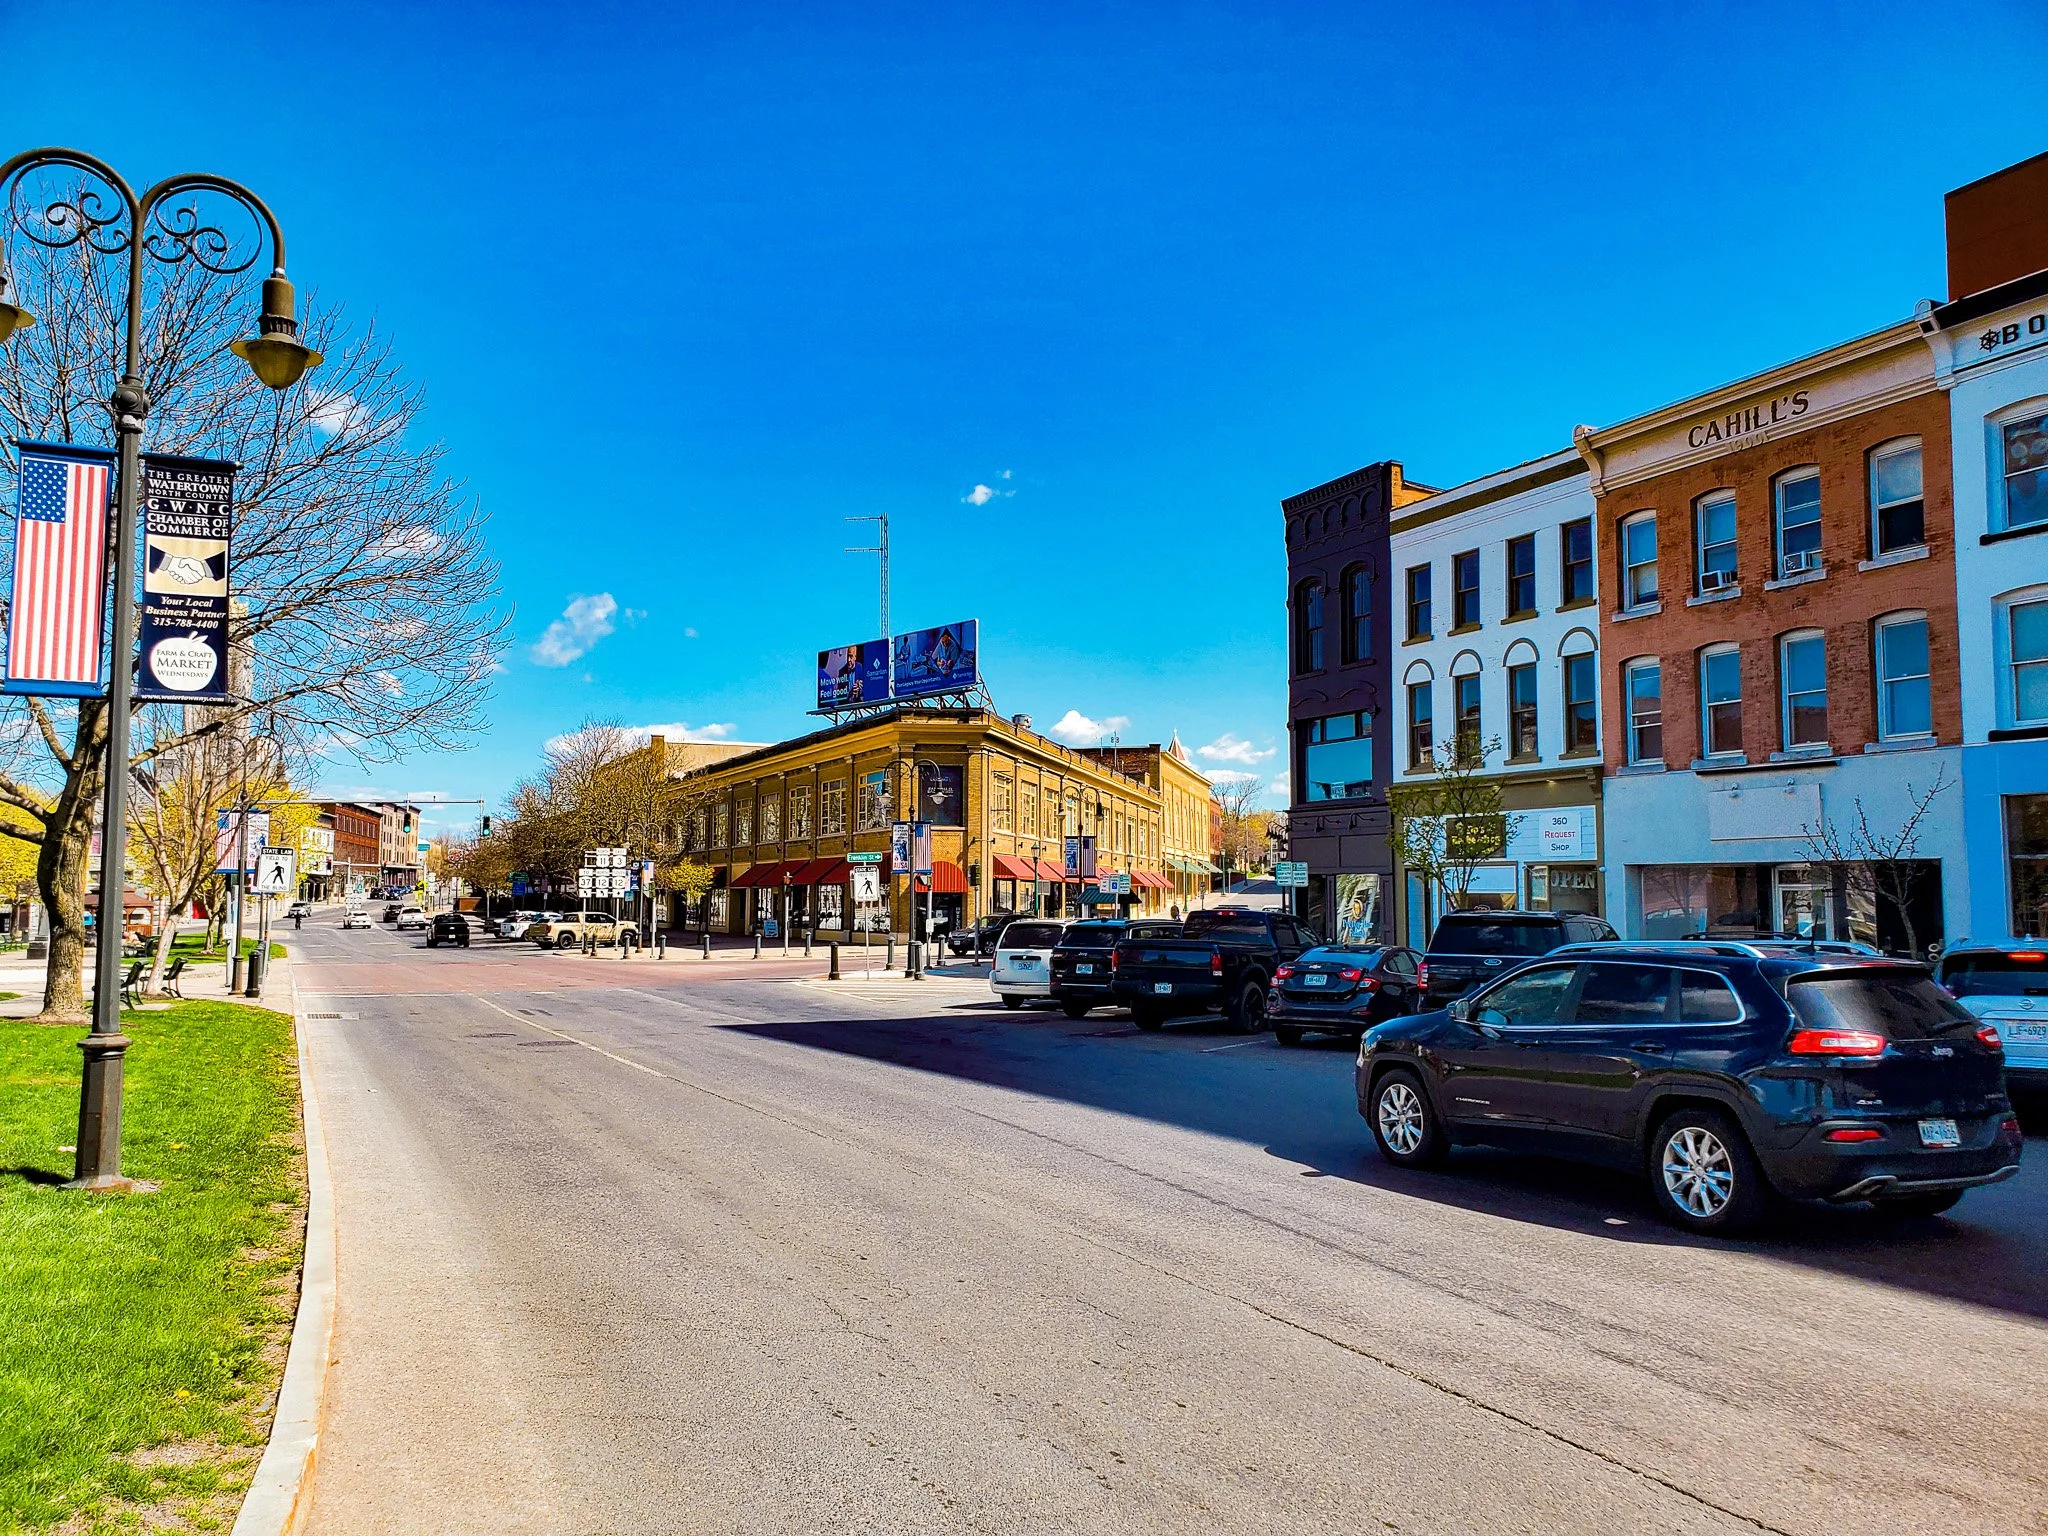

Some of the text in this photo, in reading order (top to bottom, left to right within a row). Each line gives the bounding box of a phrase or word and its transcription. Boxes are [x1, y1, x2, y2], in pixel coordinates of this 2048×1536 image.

[1688, 391, 1810, 449] CAHILL'S
[148, 470, 230, 484] THE GREATER
[148, 478, 230, 494] WATERTOWN
[148, 488, 229, 500] NORTH COUNTRY
[147, 513, 228, 528] CHAMBER OF
[146, 523, 229, 537] COMMERCE
[161, 596, 213, 607] Your Local
[146, 606, 226, 618] Business Partner
[152, 618, 218, 628] 315-788-4400
[157, 658, 212, 669] MARKET
[820, 678, 835, 686] Move
[141, 694, 224, 702] www.watertownny.com
[820, 689, 832, 698] Feel
[1552, 817, 1567, 826] 360
[1551, 870, 1595, 889] OPEN
[1932, 1046, 1954, 1057] Jeep
